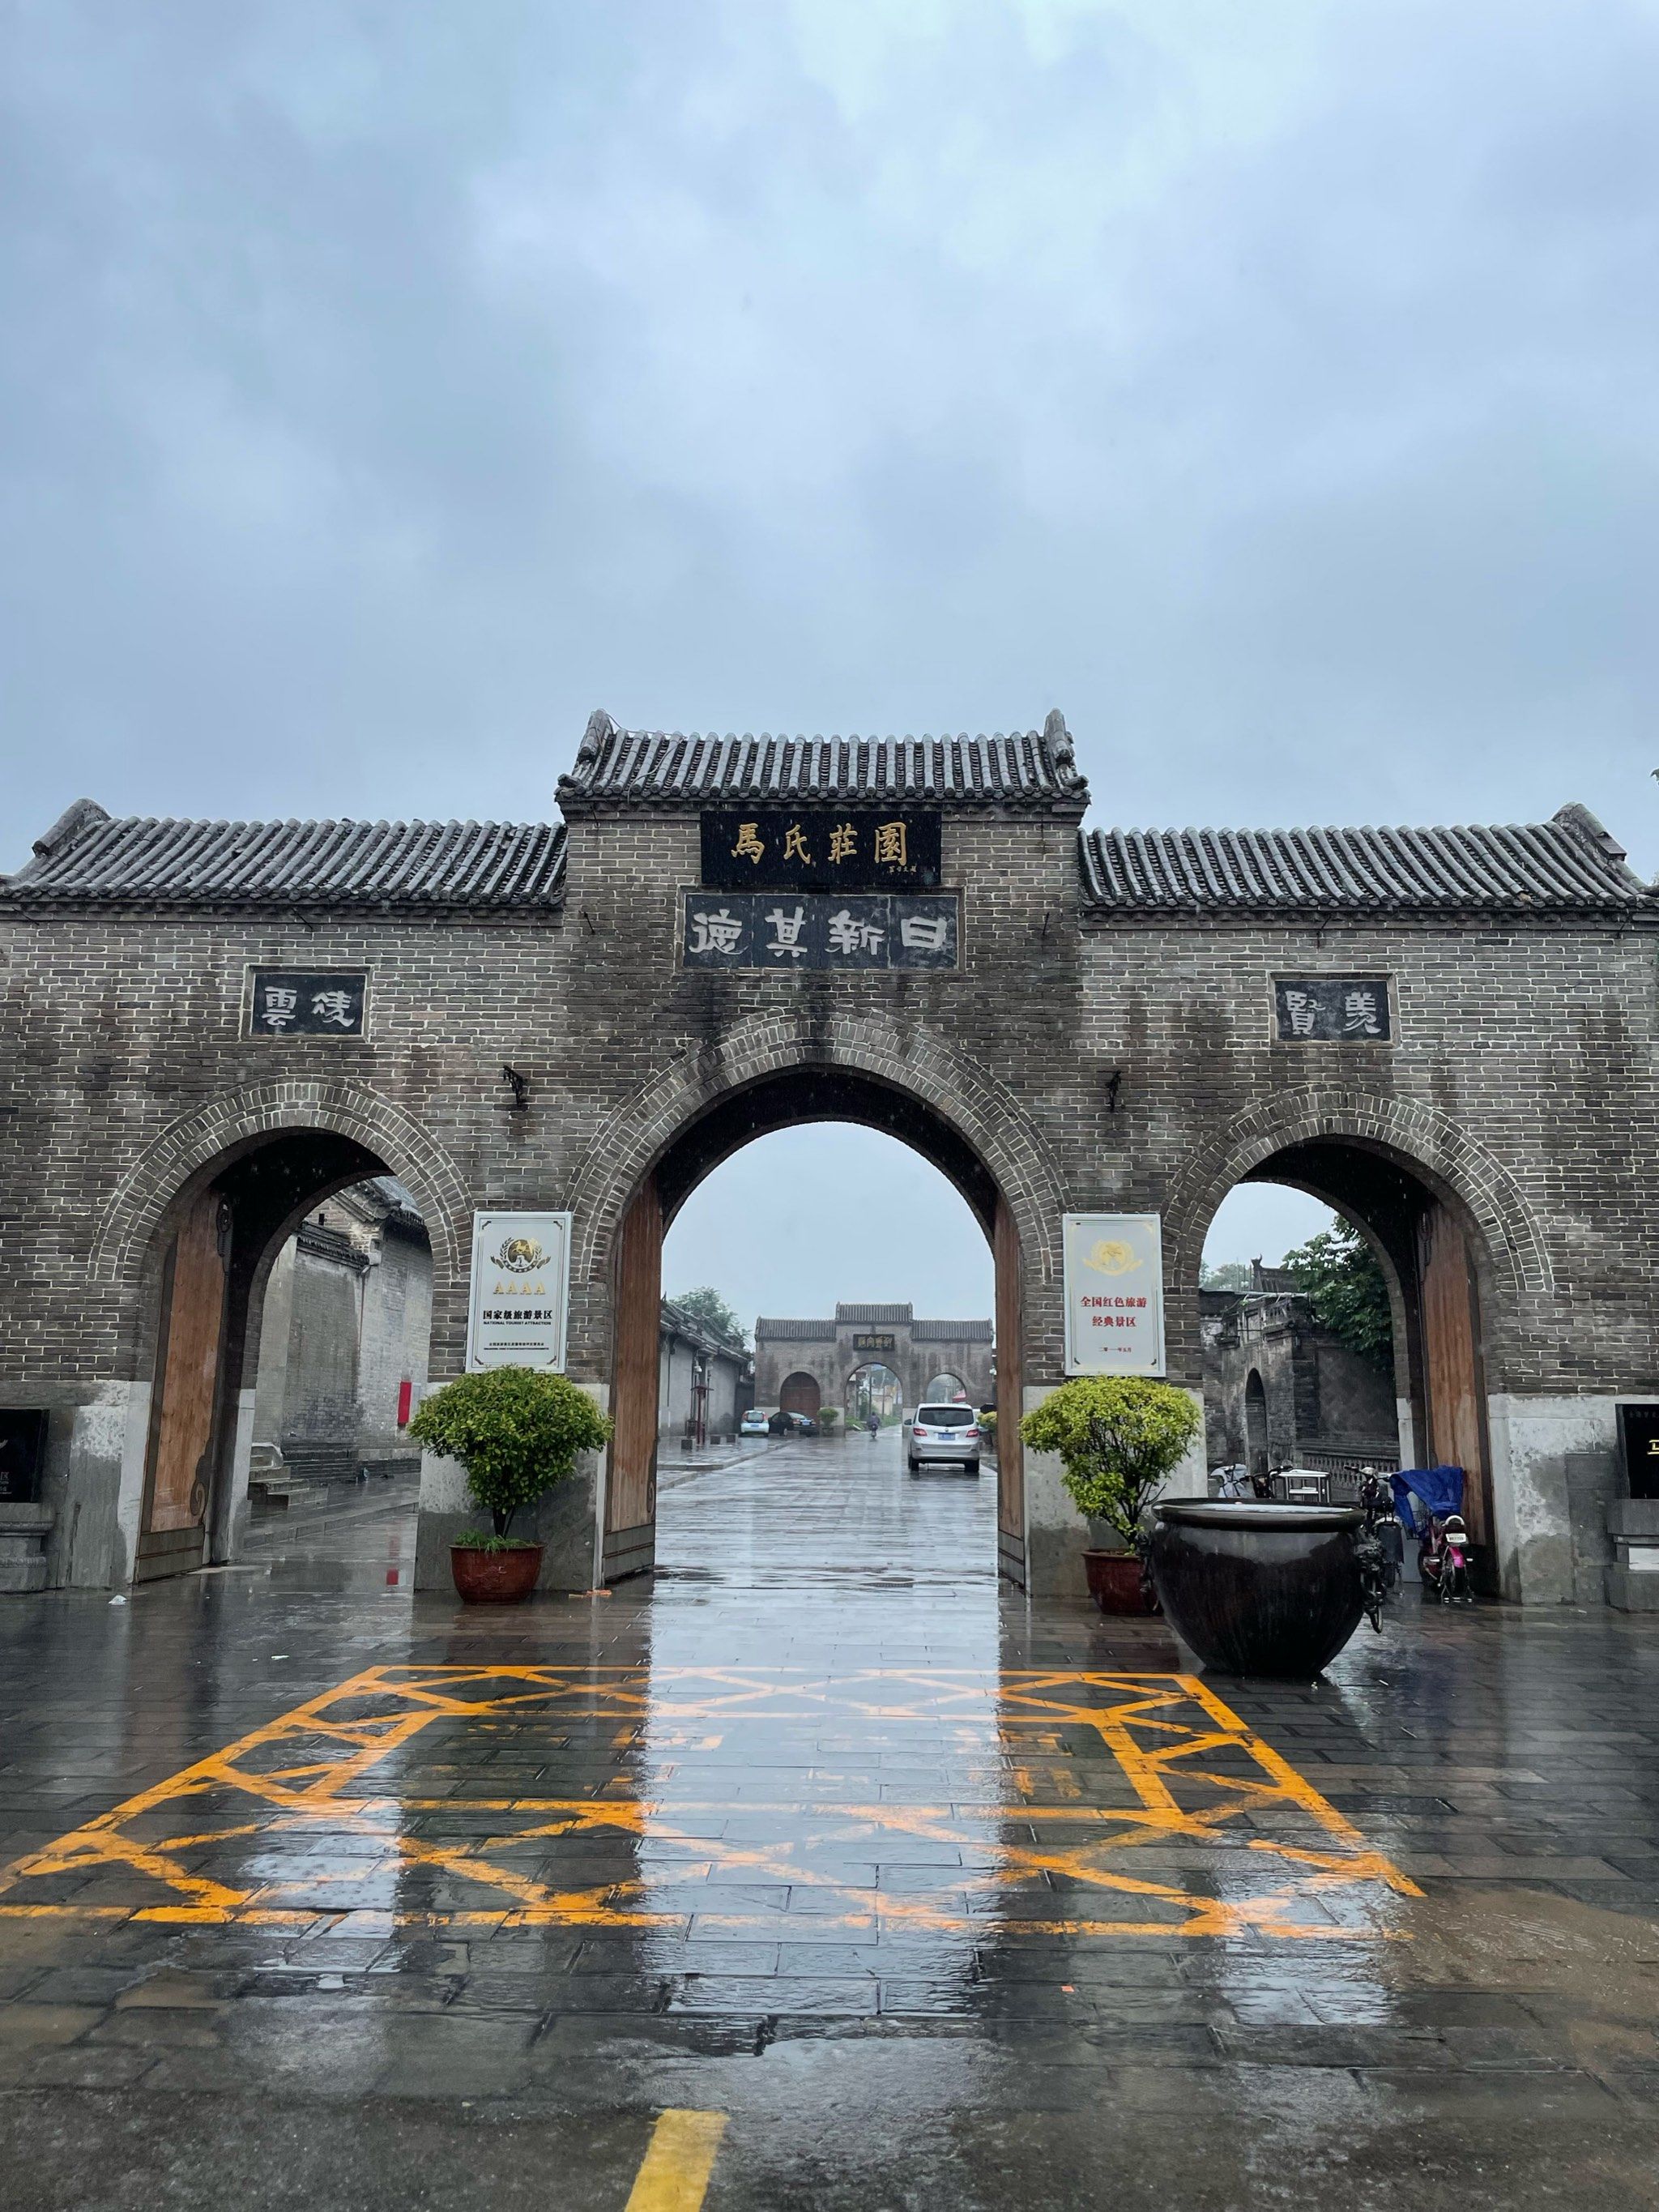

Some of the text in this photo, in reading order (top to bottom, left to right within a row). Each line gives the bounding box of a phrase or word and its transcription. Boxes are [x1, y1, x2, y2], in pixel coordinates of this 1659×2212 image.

[731, 822, 908, 866] 馬氏莊園
[1081, 1296, 1147, 1308] 全国红色旅游
[483, 1309, 552, 1320] 国家级旅游景区
[1092, 1316, 1136, 1327] 经典景区
